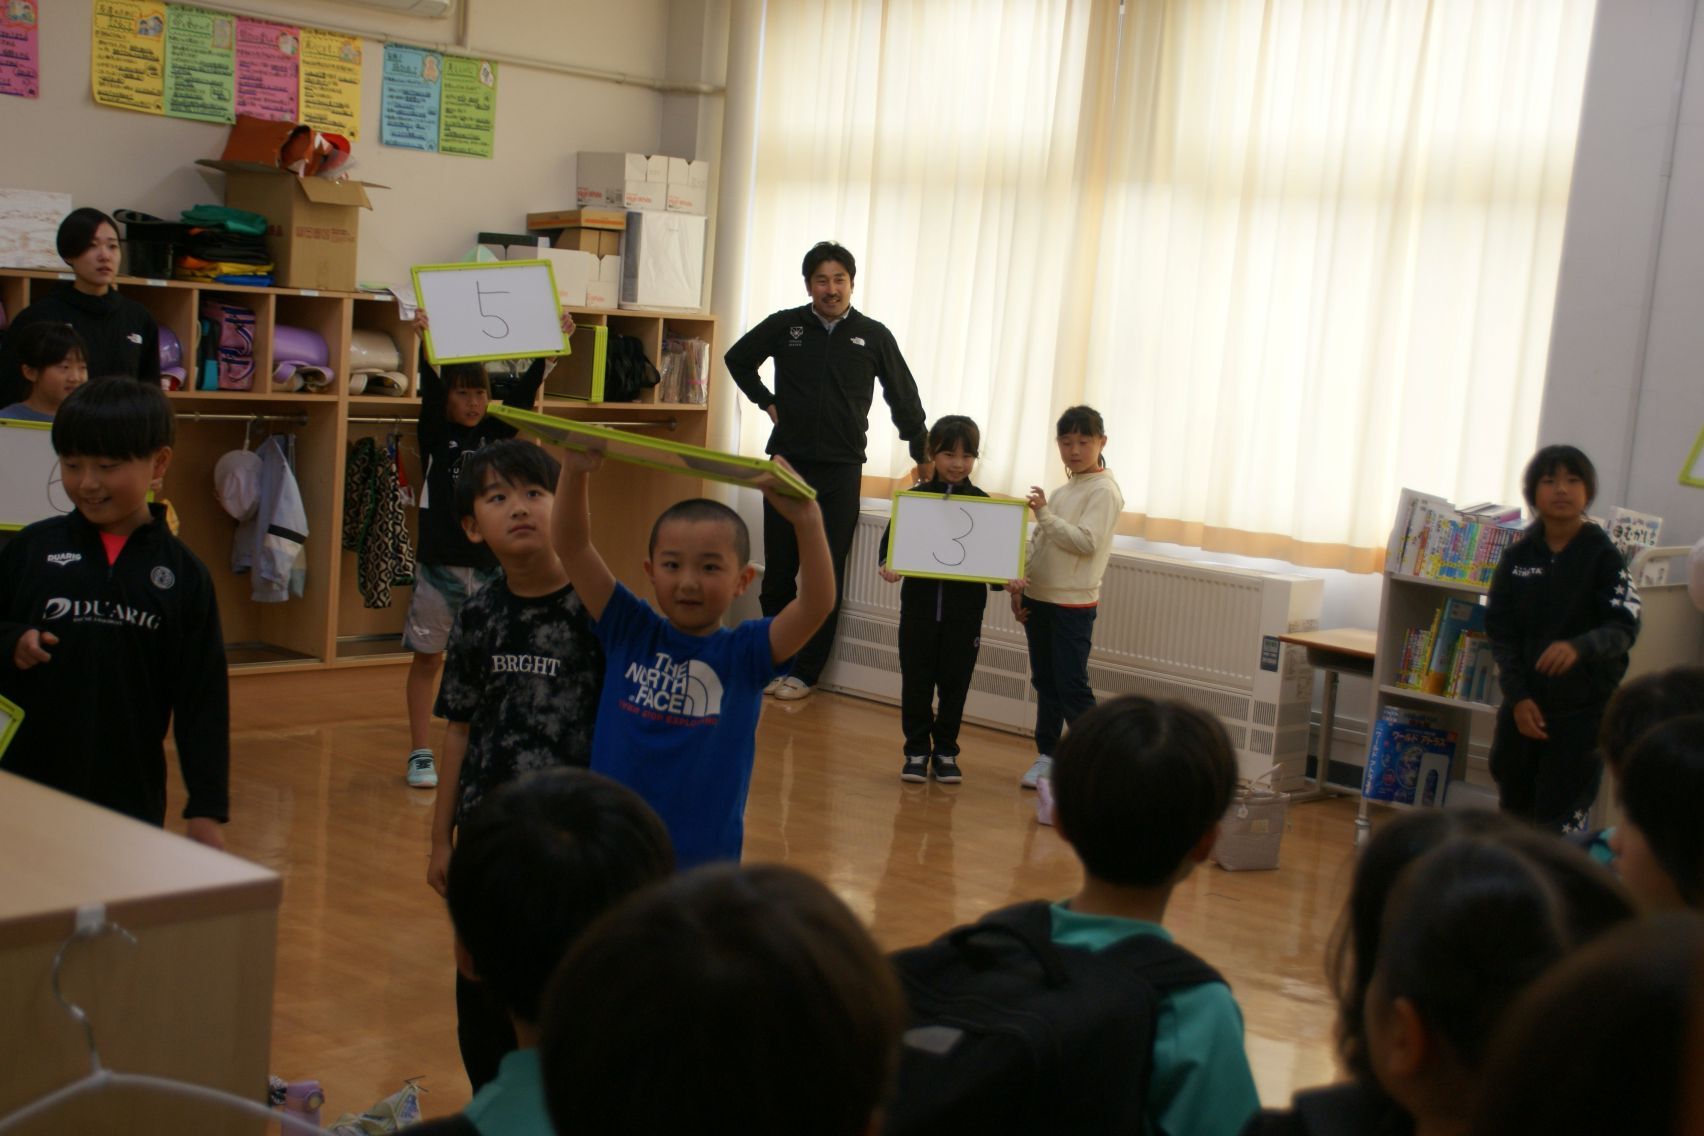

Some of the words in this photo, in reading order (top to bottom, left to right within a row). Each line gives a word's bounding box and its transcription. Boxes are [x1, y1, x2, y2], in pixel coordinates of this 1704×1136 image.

[476, 280, 512, 340] 5
[932, 506, 975, 568] 3
[47, 552, 82, 562] DUARIG
[73, 599, 162, 630] DUARIG
[491, 654, 560, 676] BRGHT
[656, 652, 688, 679] THE
[635, 686, 684, 713] FACE
